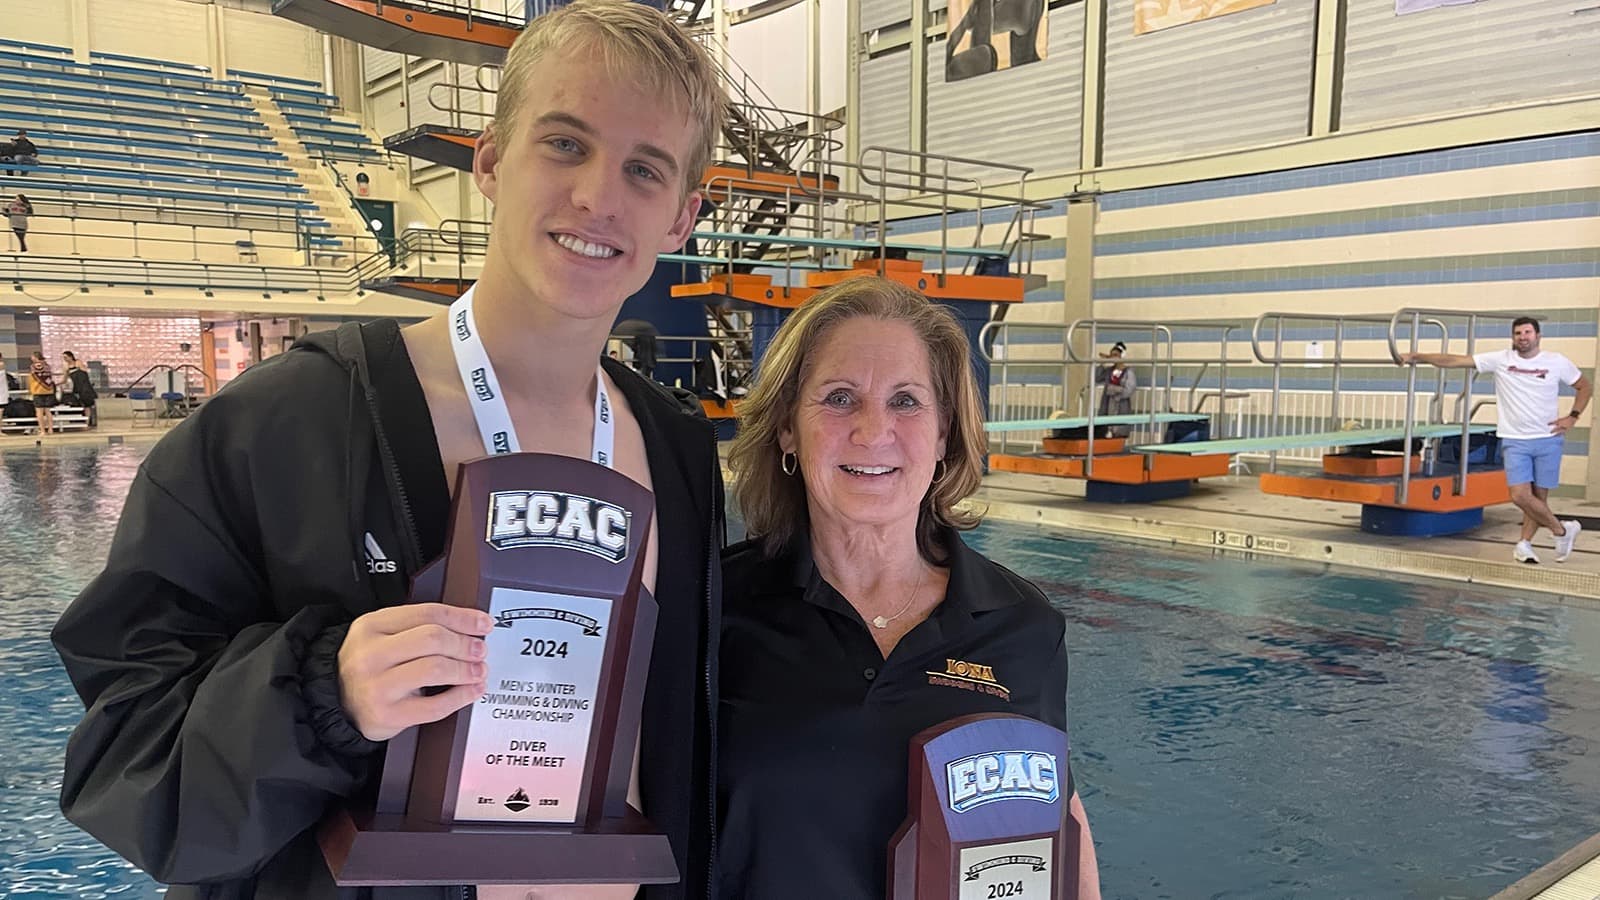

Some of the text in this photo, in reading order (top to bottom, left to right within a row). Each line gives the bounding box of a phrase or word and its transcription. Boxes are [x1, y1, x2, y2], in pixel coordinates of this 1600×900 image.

[472, 368, 494, 401] ECAC
[490, 492, 629, 556] ECAC
[1213, 531, 1225, 545] 13
[366, 558, 398, 574] das
[520, 638, 568, 658] 2024
[946, 658, 997, 682] IONA
[500, 679, 577, 695] MEN'S WINTER
[480, 693, 589, 710] SWIMMING & DIVING
[492, 708, 575, 723] CHAMPIONSHIP
[510, 740, 547, 752] DIVER
[486, 754, 566, 768] OF THE MEET
[950, 751, 1057, 807] ECAC
[987, 880, 1024, 900] 2024
